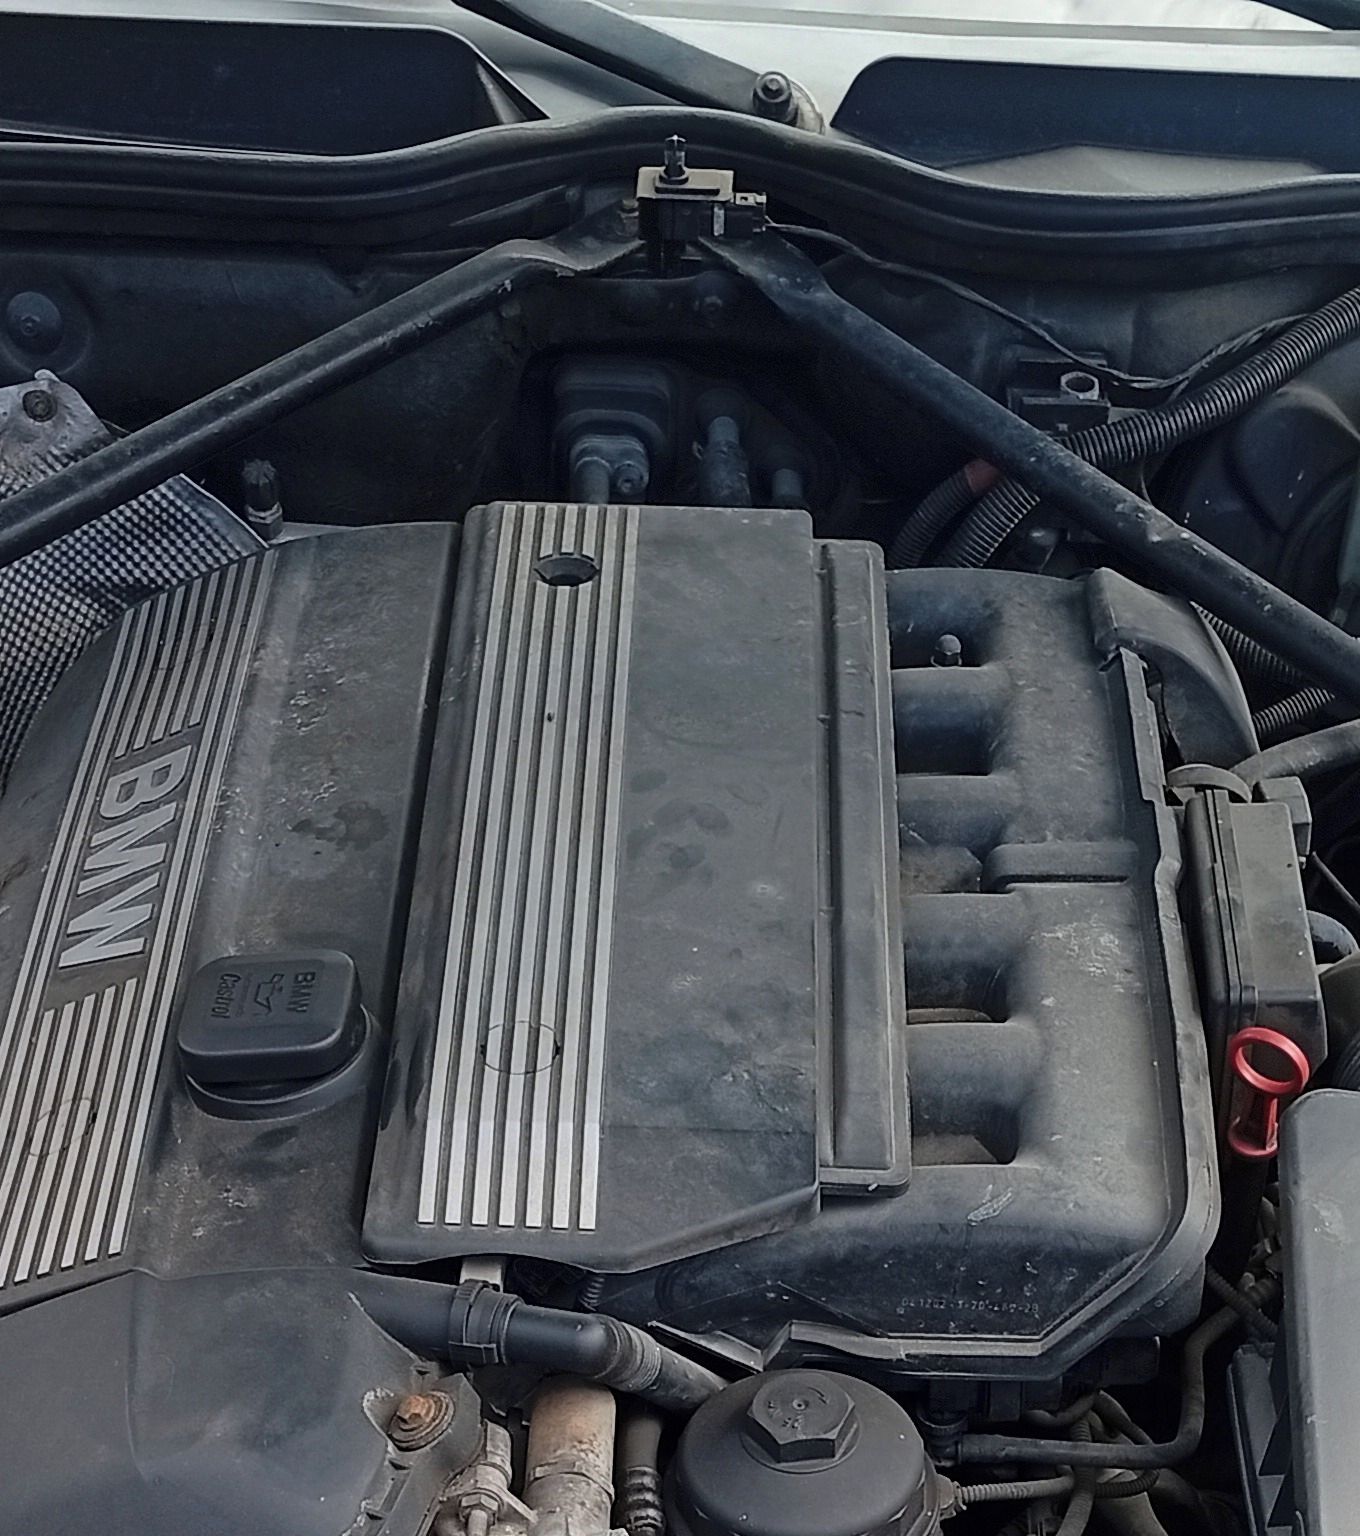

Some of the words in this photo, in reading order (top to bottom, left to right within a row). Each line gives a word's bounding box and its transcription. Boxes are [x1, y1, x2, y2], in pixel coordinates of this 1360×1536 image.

[58, 744, 193, 969] BMW
[211, 973, 242, 1018] Castrol
[286, 972, 316, 1013] BMW
